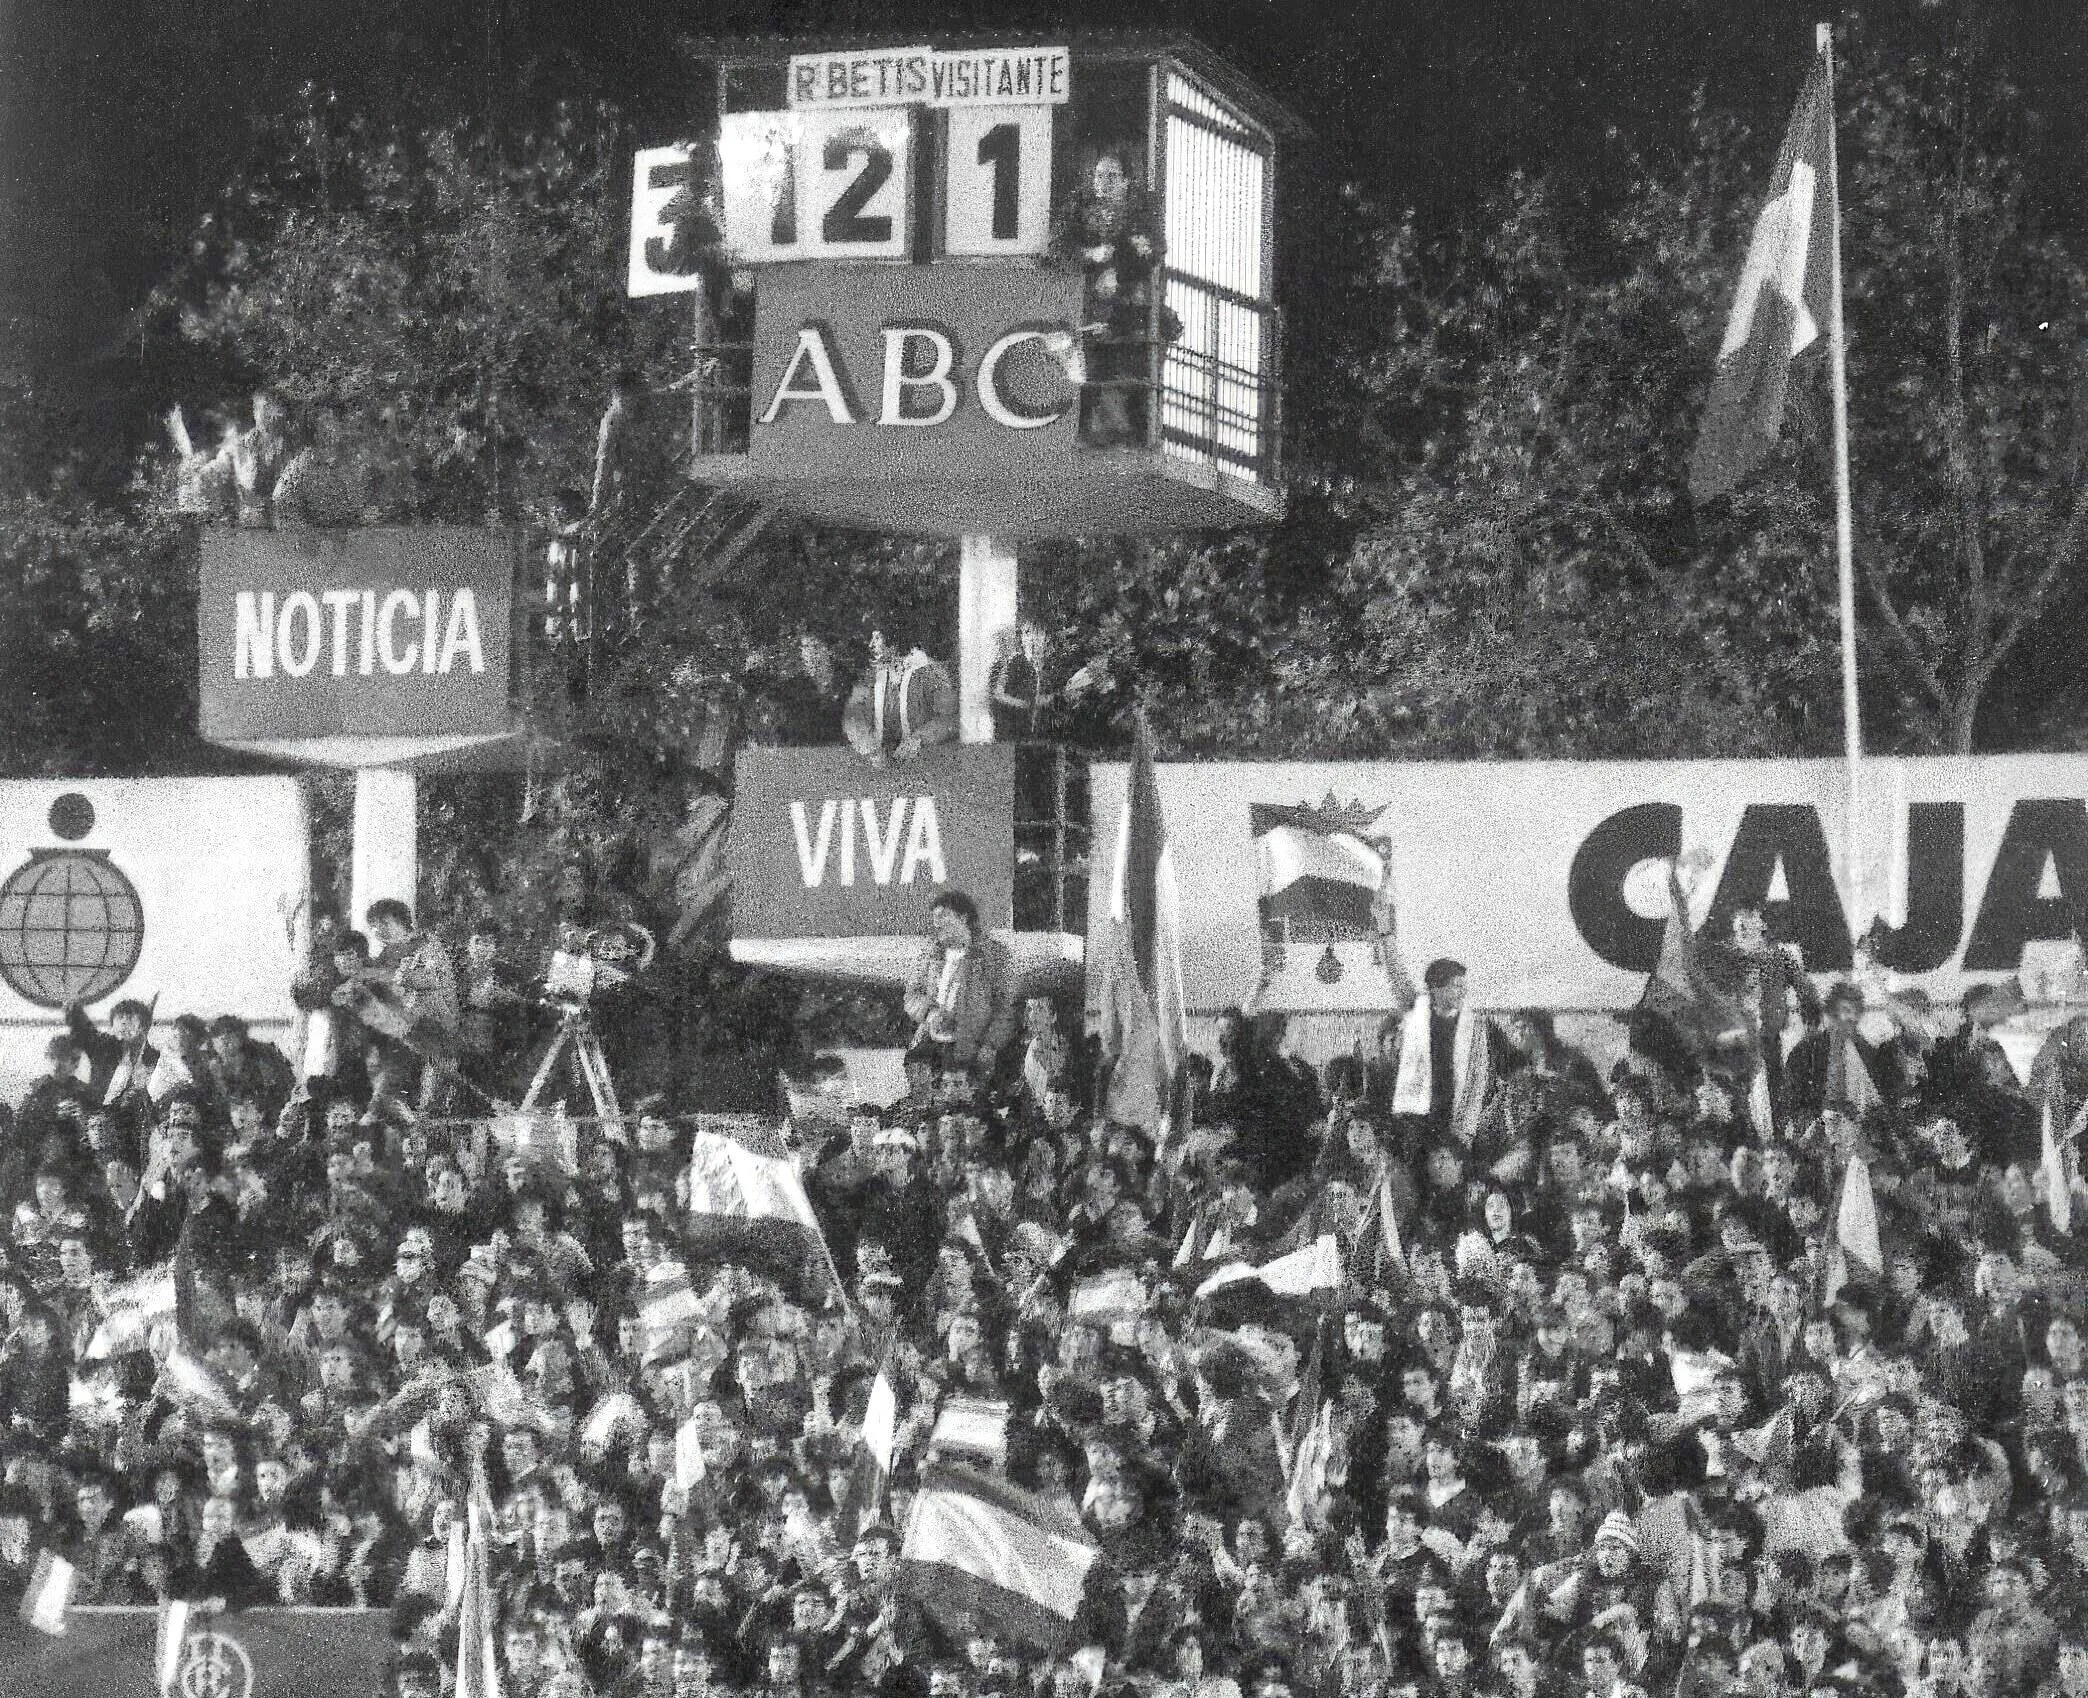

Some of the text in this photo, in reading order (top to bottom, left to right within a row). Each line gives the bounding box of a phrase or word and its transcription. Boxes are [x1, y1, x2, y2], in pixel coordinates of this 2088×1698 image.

[827, 56, 928, 99] BETIS
[932, 54, 1063, 98] VISITANTE
[823, 130, 892, 242] 2
[977, 124, 1020, 239] 1
[759, 328, 1068, 429] ABC
[234, 587, 485, 680] NOTICIA
[790, 797, 947, 888] VIVA
